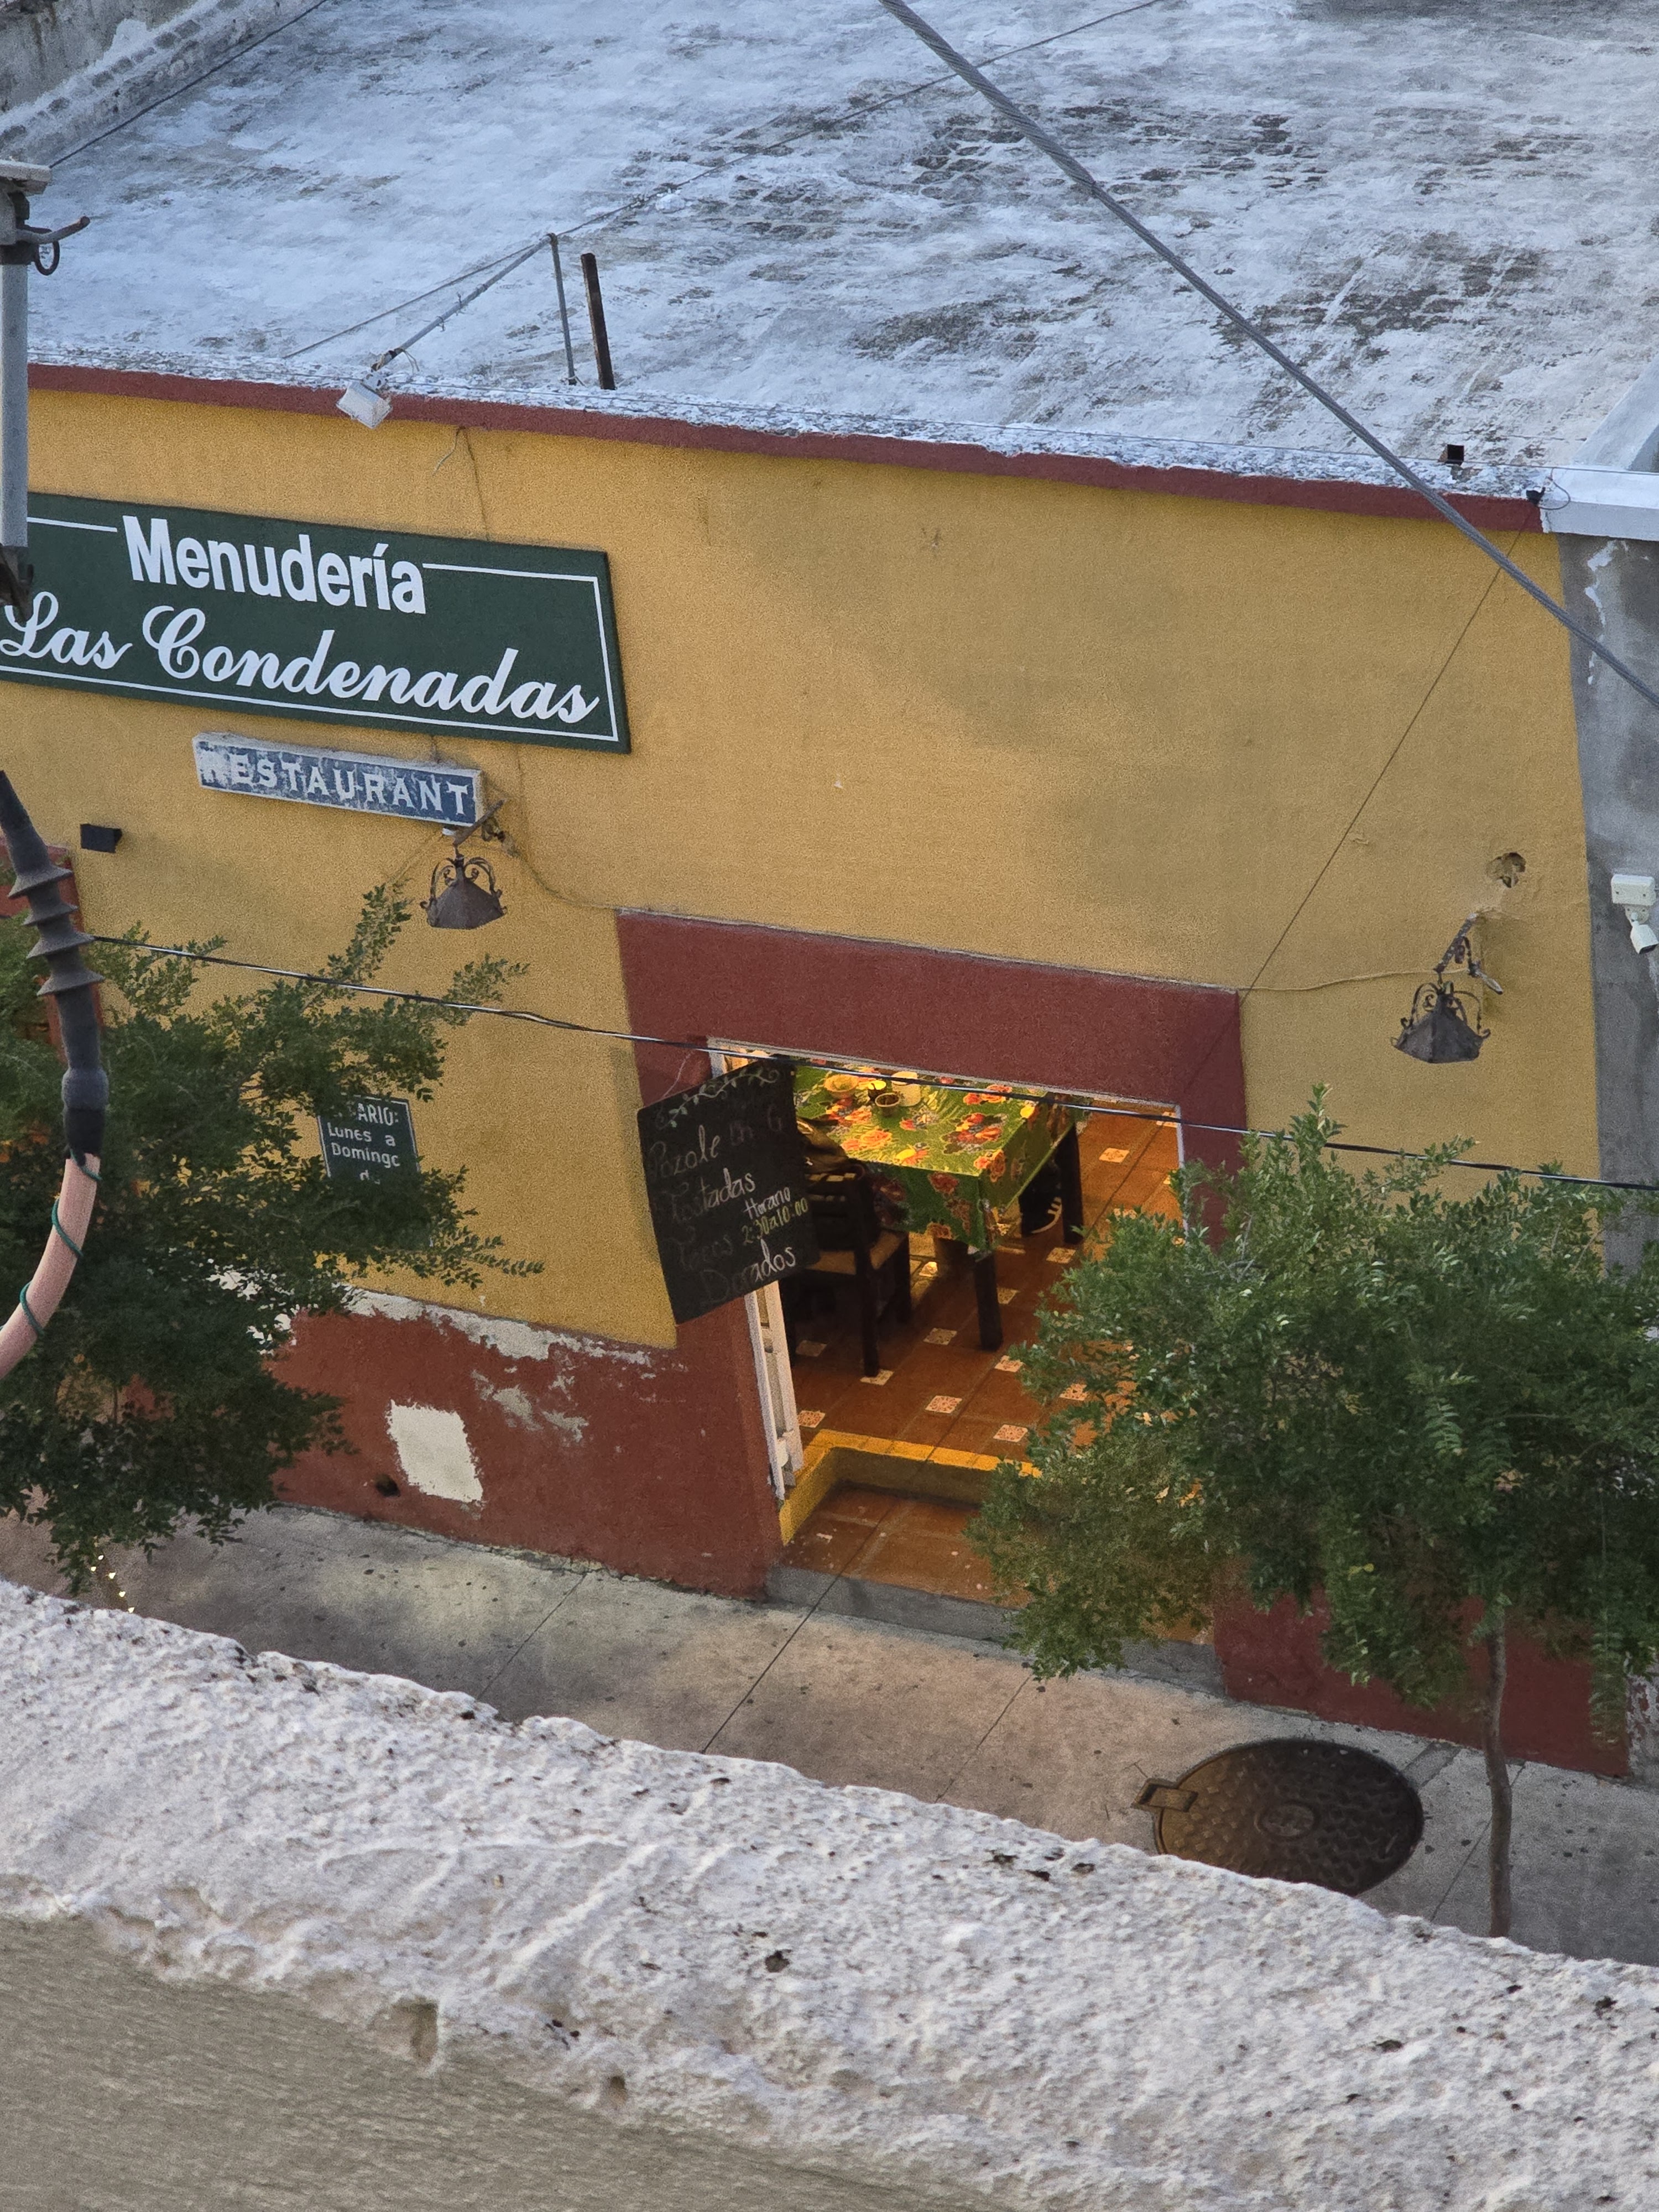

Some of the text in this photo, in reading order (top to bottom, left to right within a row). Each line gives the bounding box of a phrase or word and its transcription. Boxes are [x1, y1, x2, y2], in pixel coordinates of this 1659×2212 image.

[122, 515, 426, 614] Menudería
[0, 591, 599, 723] Las Condenadas
[327, 1122, 396, 1147] Lunes a
[649, 1125, 721, 1178] Pozole
[661, 1167, 757, 1222] Tostadas
[743, 1186, 791, 1220] Horario
[700, 1239, 796, 1303] Dorados
